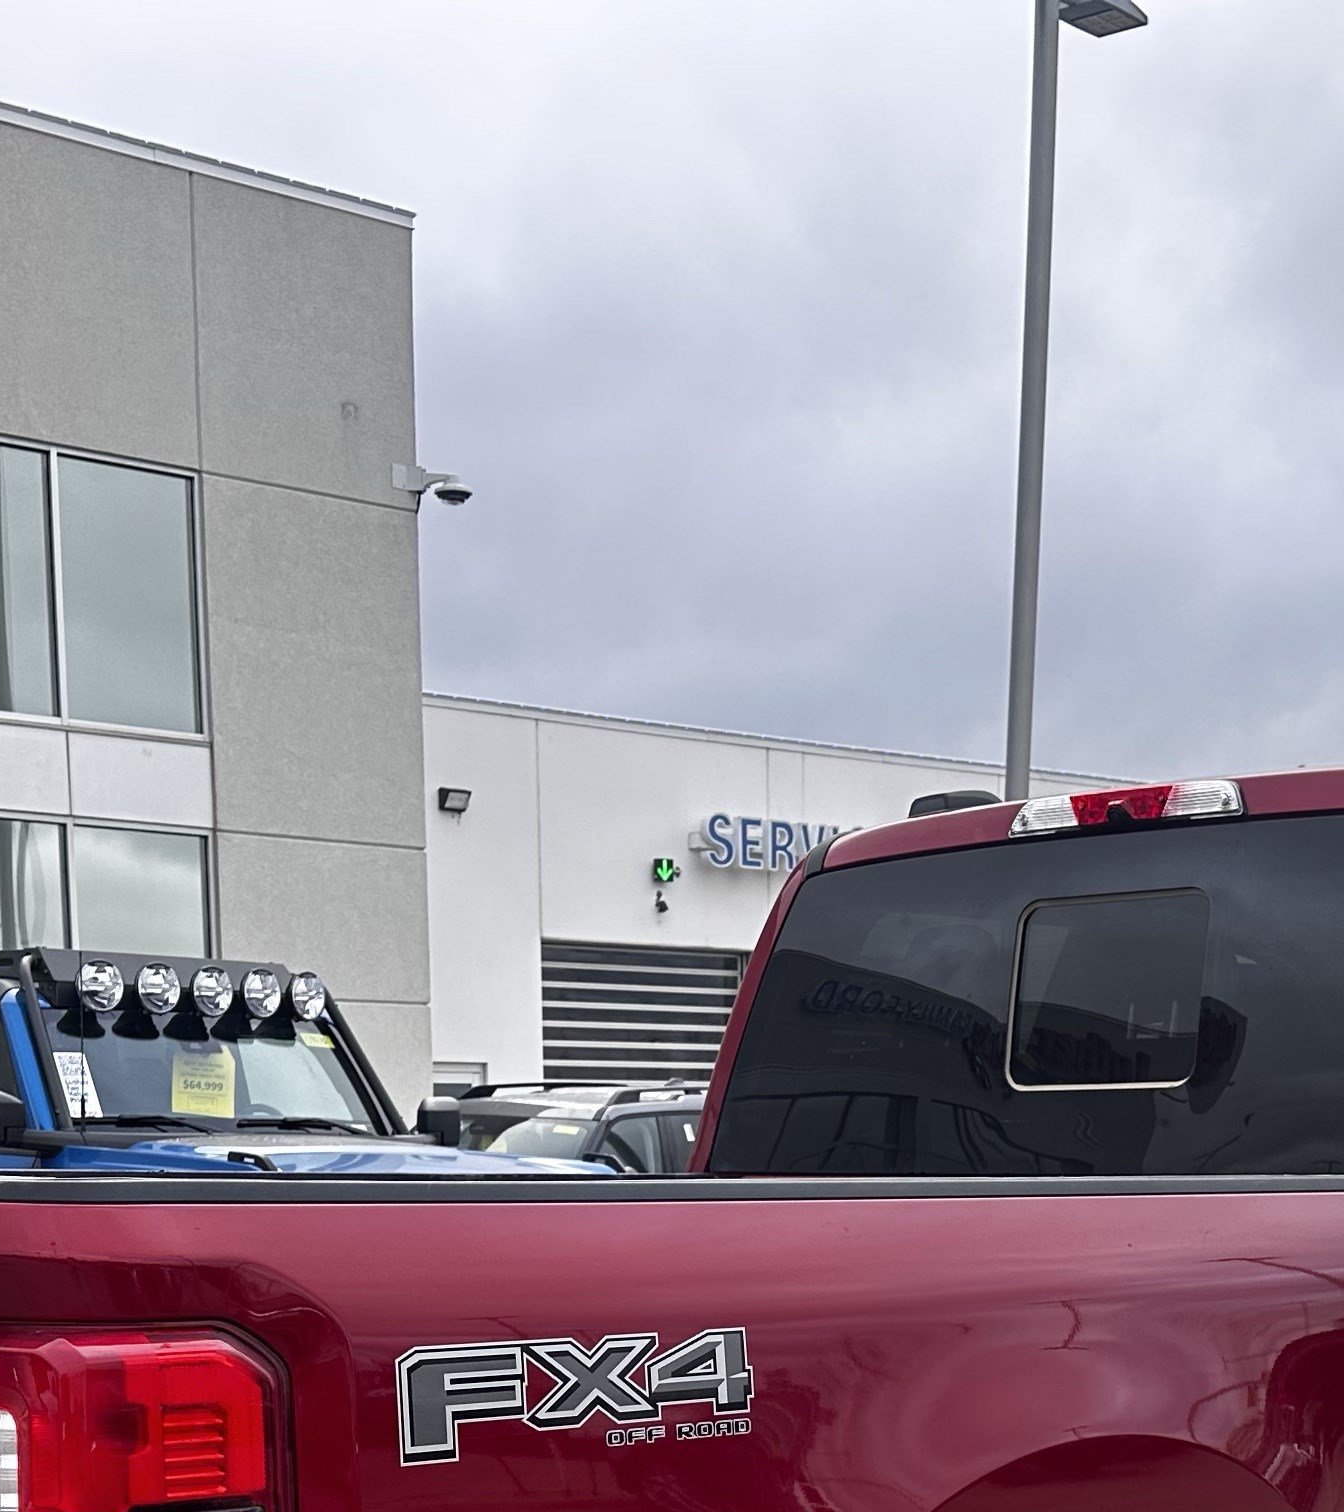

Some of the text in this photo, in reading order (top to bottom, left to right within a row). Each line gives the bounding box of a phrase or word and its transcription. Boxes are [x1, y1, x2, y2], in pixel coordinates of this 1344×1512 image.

[706, 812, 862, 872] SERV
[182, 1079, 224, 1092] $64,999
[395, 1326, 755, 1467] FX4
[605, 1418, 752, 1447] OFF ROAD
